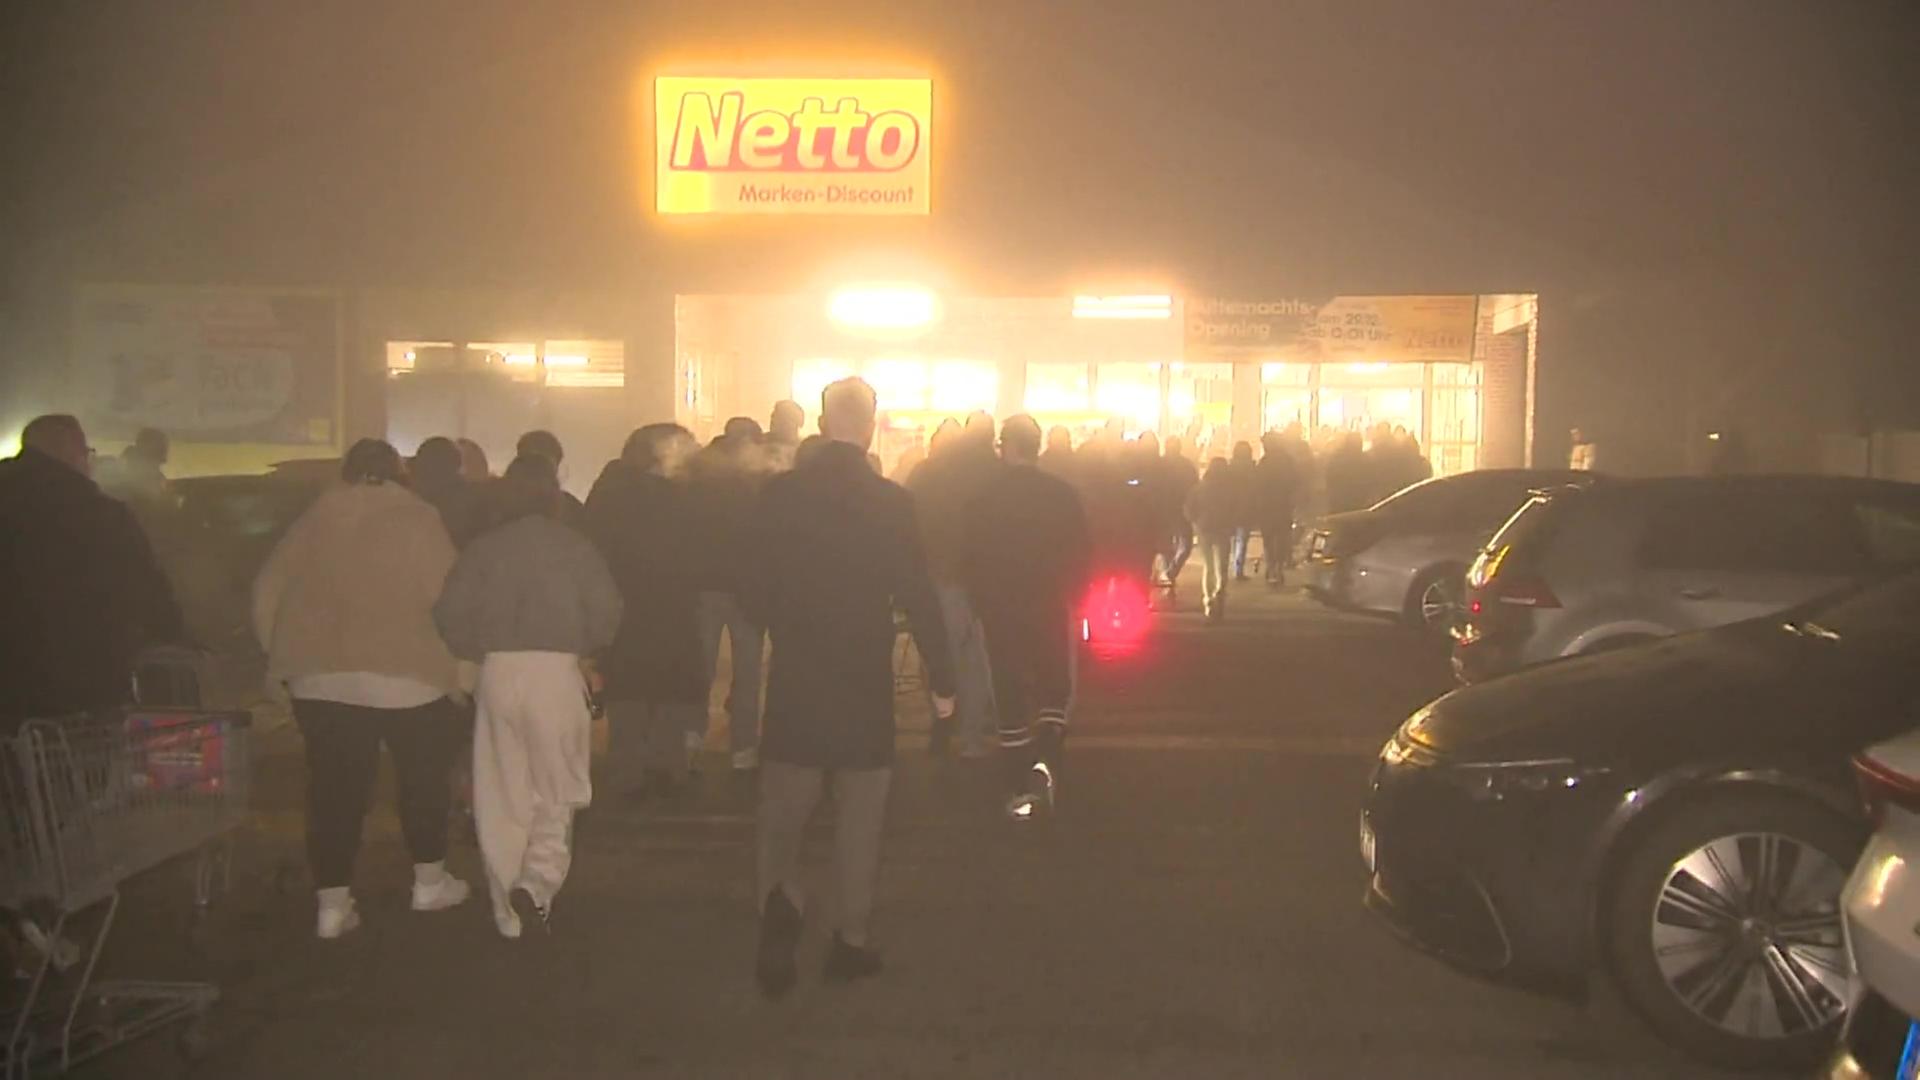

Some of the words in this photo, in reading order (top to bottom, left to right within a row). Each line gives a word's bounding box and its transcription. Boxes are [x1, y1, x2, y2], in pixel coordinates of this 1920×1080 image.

[670, 91, 919, 172] Netto
[738, 184, 914, 203] Marken-Discount
[1190, 319, 1271, 341] Opening
